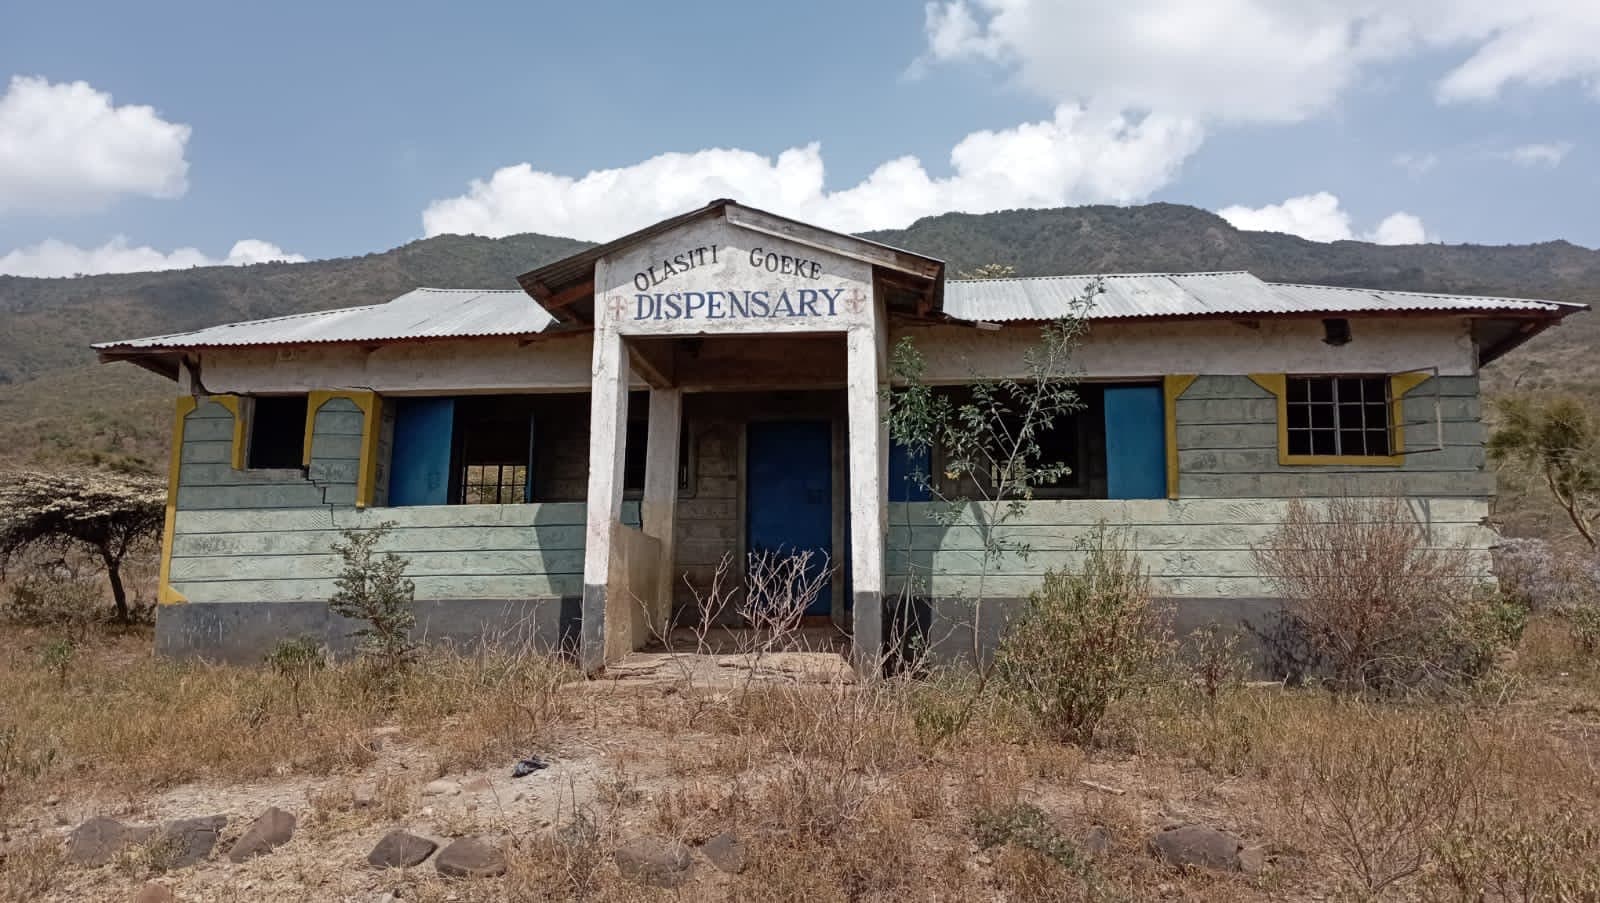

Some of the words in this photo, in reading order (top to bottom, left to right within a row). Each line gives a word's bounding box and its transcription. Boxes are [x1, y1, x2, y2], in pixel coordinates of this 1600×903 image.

[634, 244, 718, 291] OLASITI
[749, 247, 822, 281] GOEKE
[633, 288, 844, 320] DISPENSARY
